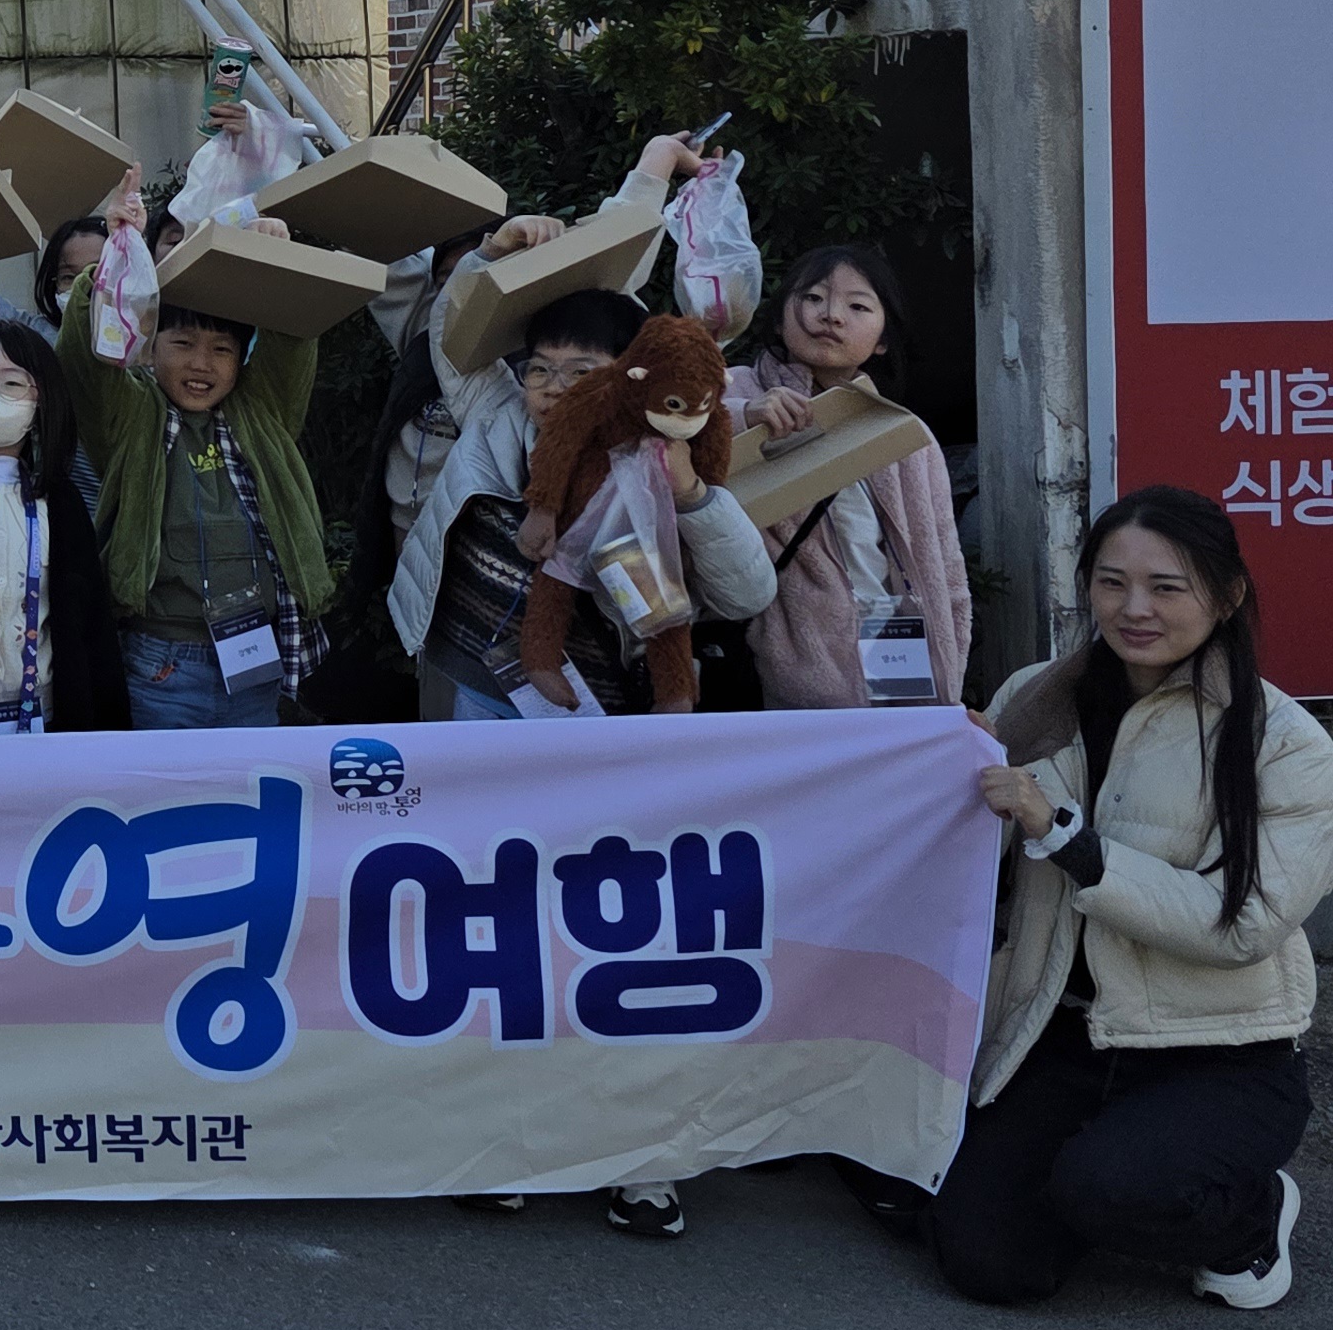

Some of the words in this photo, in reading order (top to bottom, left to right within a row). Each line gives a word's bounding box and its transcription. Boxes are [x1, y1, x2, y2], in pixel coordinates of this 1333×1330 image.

[337, 801, 373, 814] 바다의
[390, 786, 422, 818] 통영
[347, 830, 765, 1042] 여행
